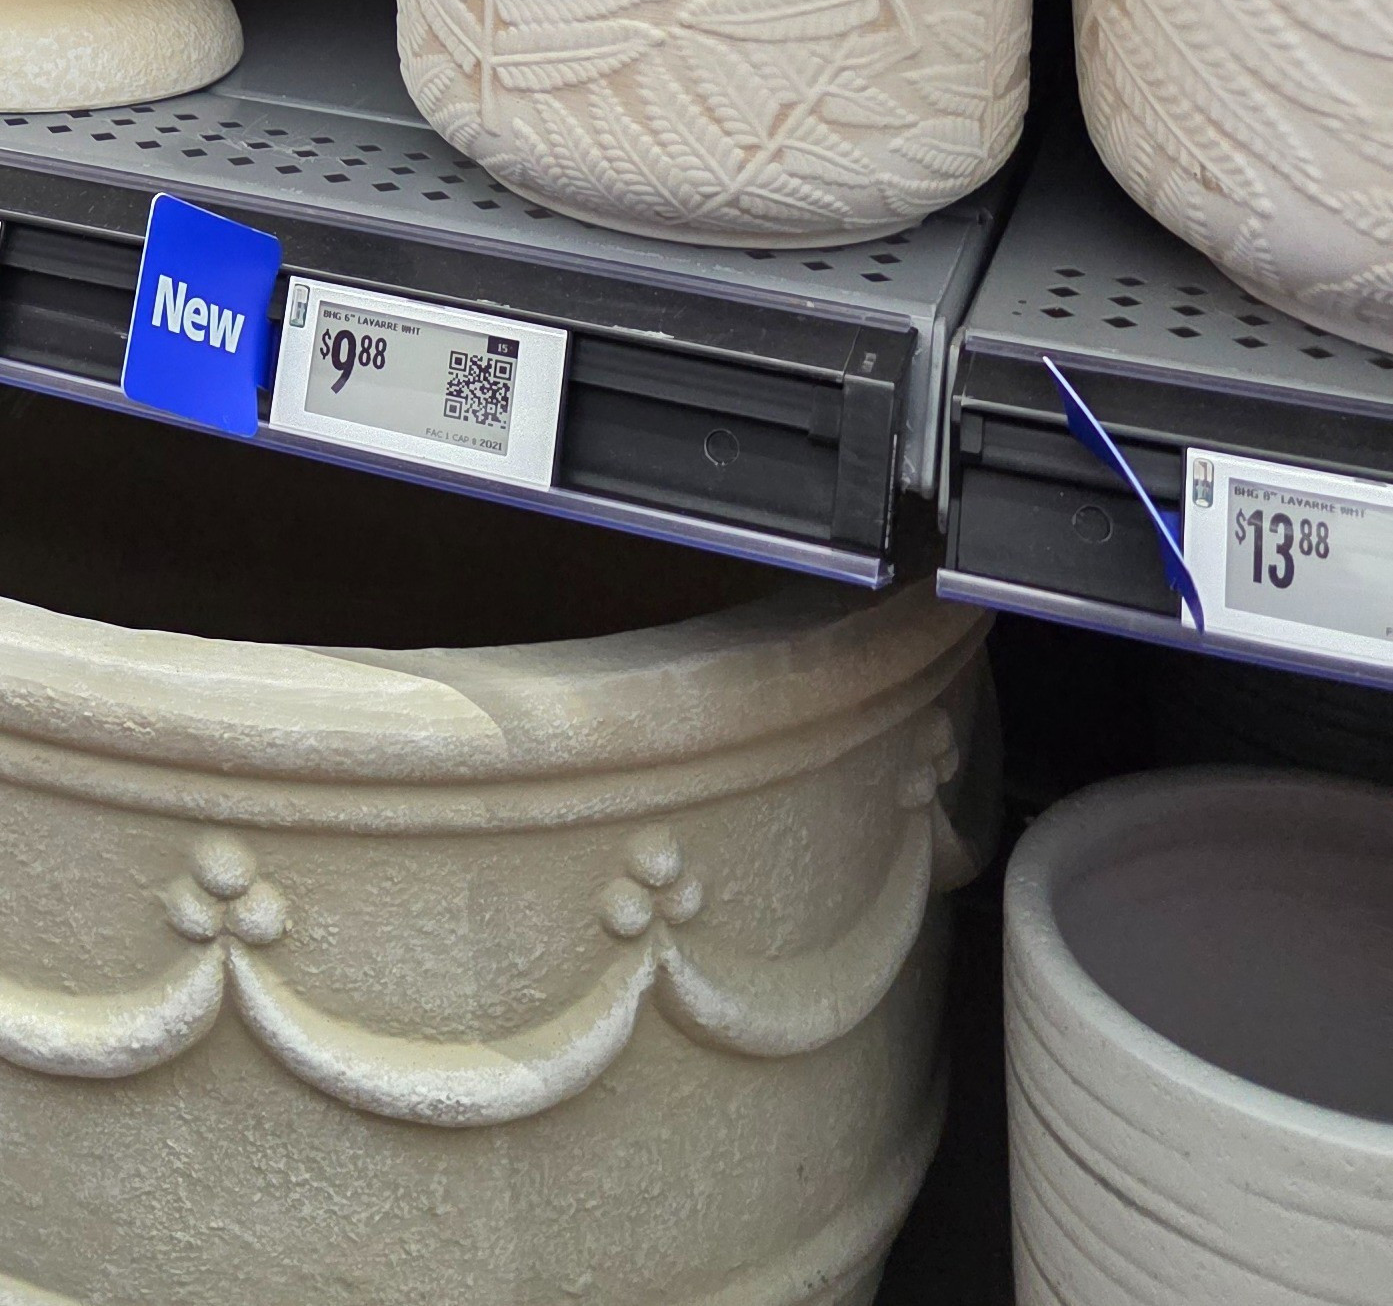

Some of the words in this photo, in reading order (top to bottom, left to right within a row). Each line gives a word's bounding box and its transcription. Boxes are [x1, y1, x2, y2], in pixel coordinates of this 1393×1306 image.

[151, 274, 246, 354] New
[323, 309, 342, 321] BHG
[358, 316, 399, 332] LAVARRE
[426, 428, 443, 438] FAC
[452, 433, 469, 443] CAP
[479, 438, 502, 451] 2021
[1234, 486, 1259, 499] BHG
[1281, 494, 1337, 514] LAVARRE
